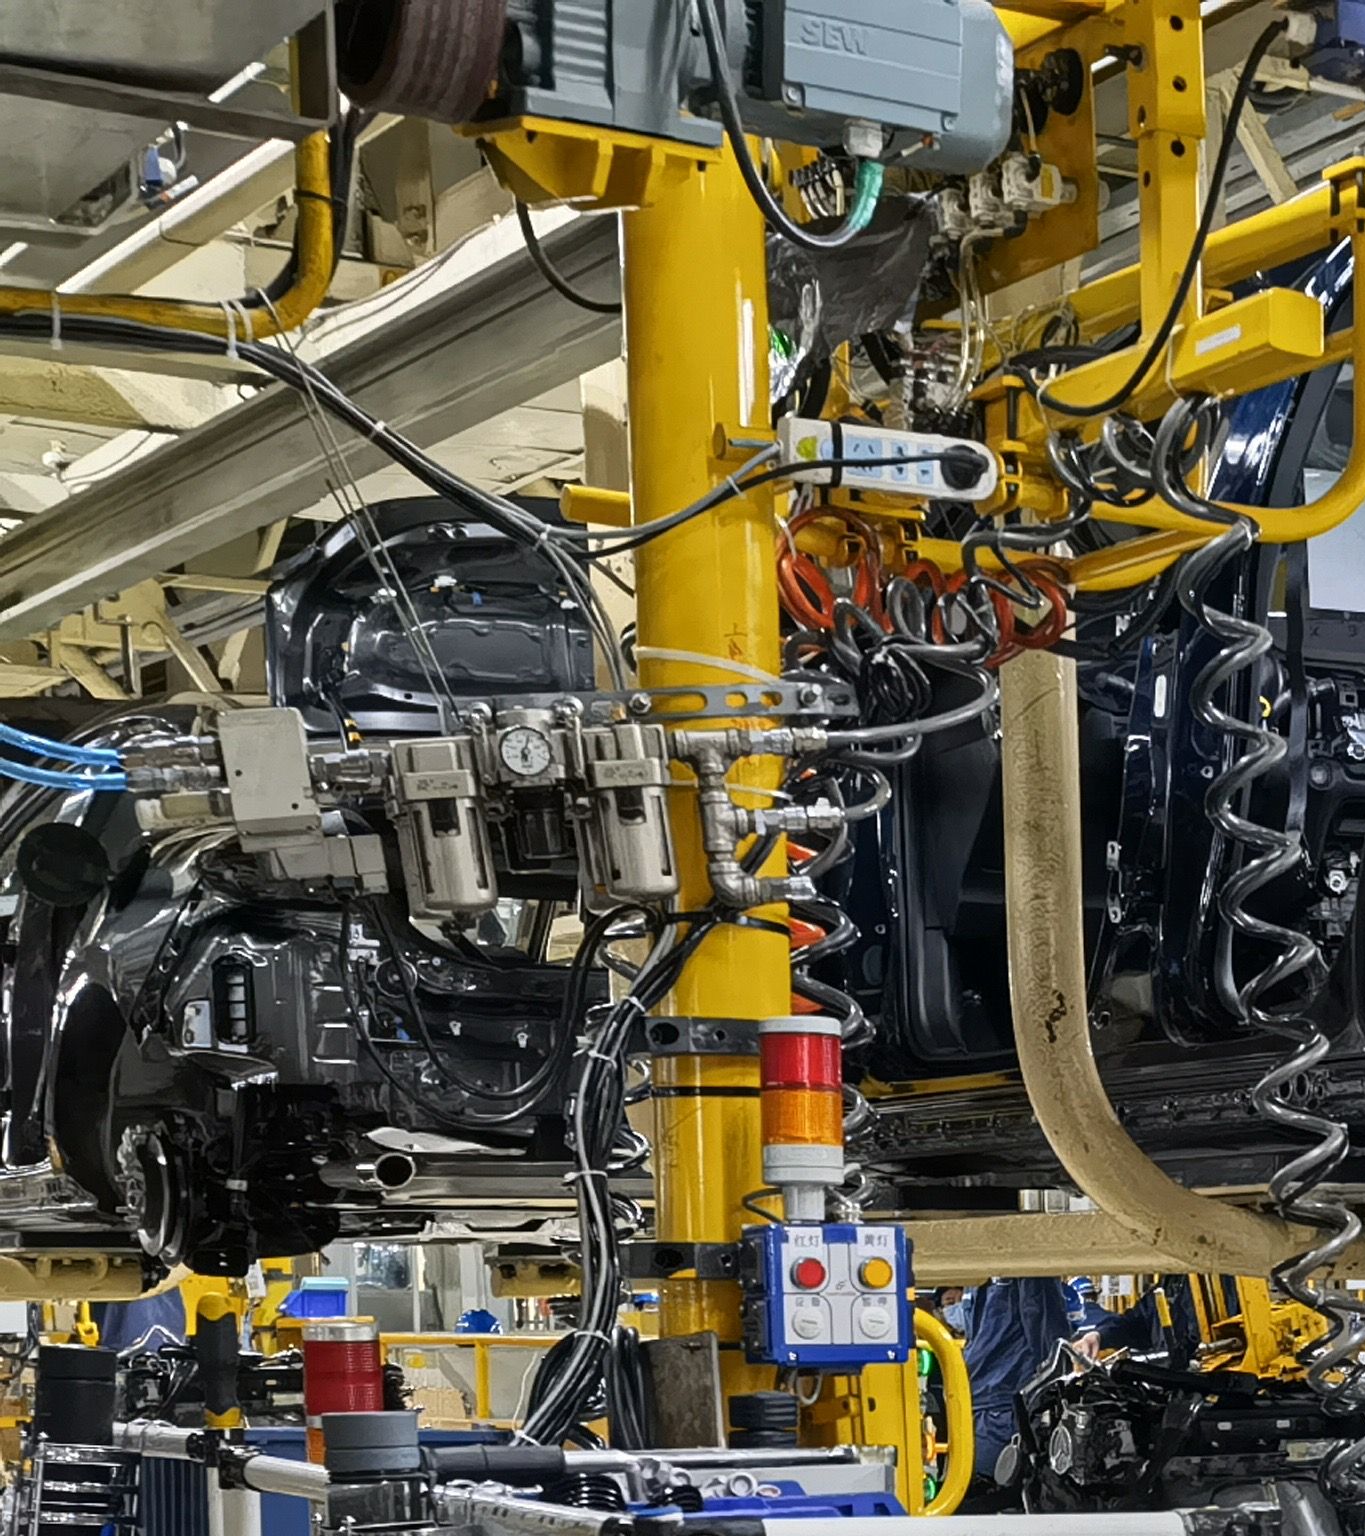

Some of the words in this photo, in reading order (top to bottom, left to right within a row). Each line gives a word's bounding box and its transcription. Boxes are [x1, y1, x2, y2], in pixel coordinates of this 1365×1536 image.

[799, 19, 868, 56] SEW
[794, 1234, 820, 1248] 红灯
[864, 1233, 888, 1247] 黄灯
